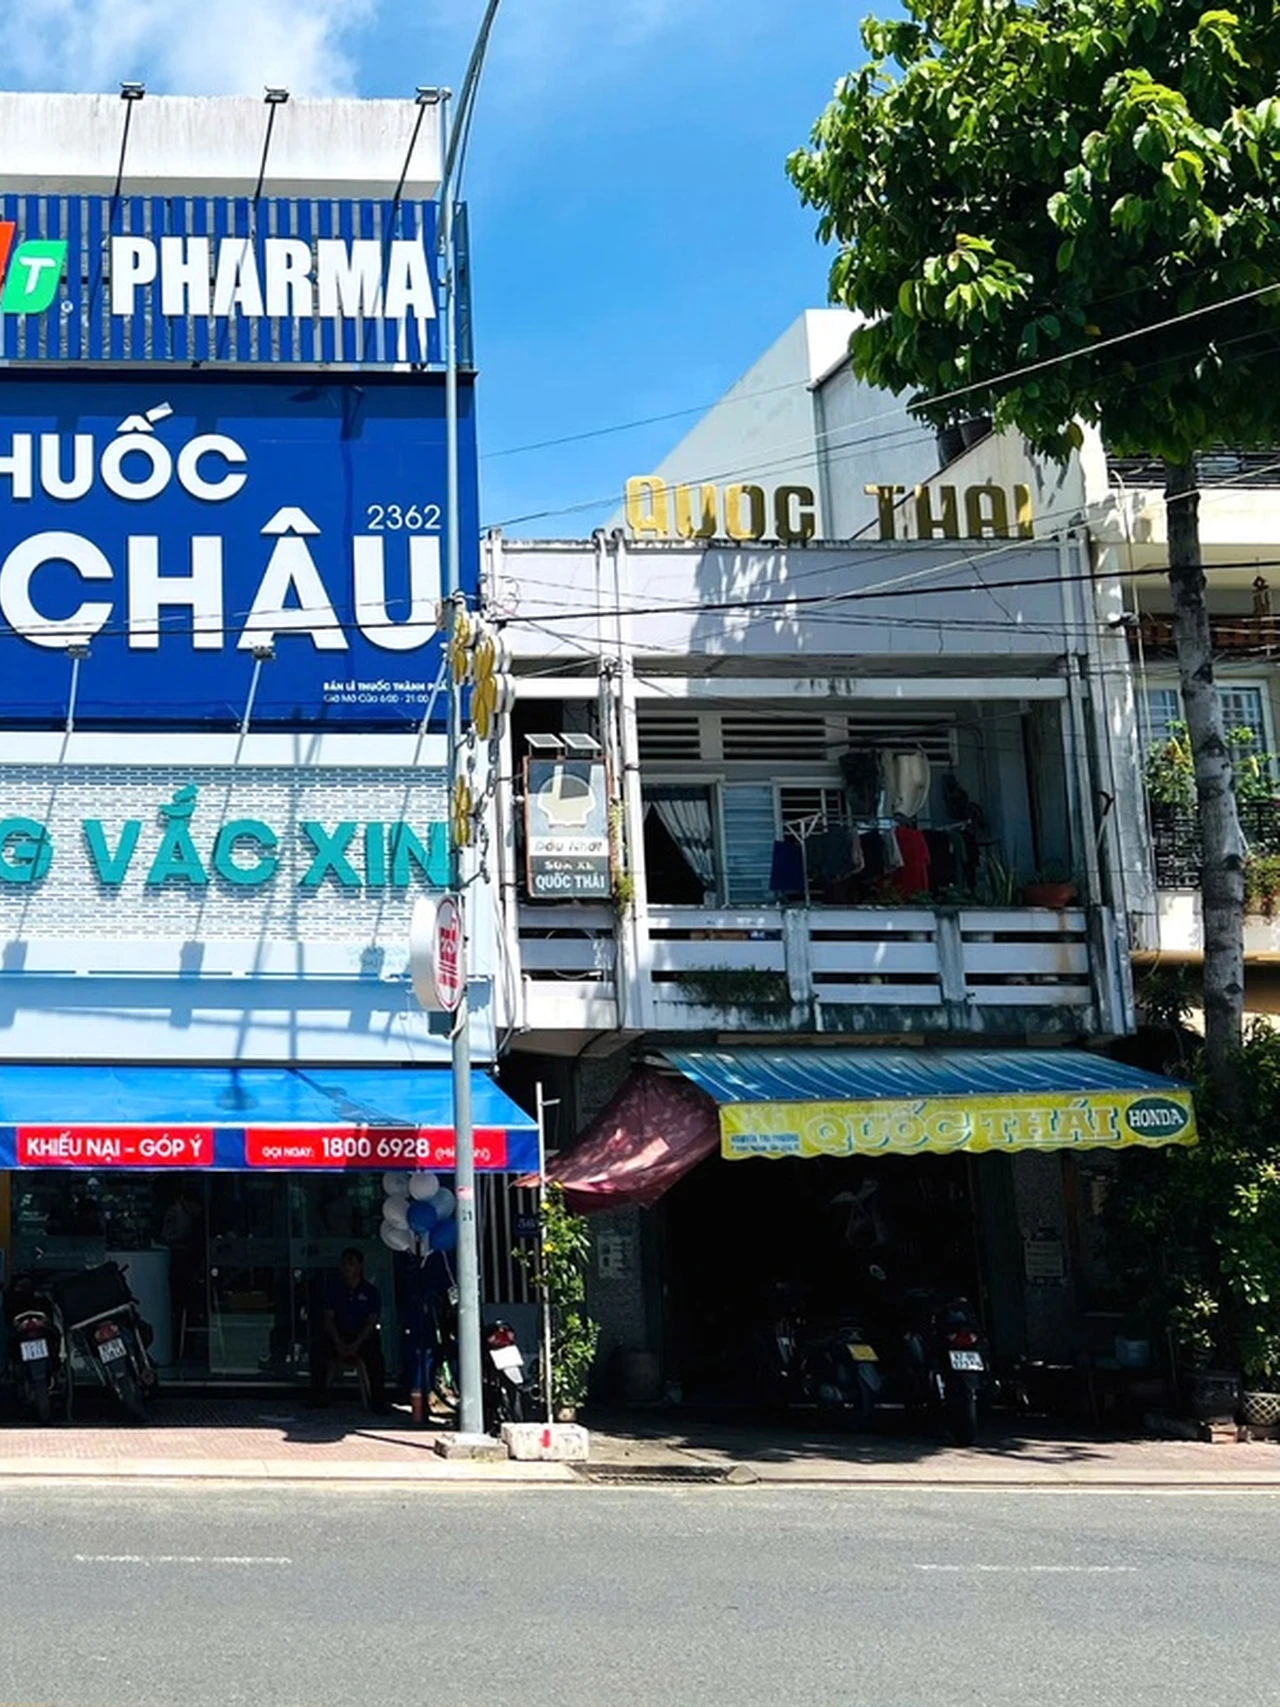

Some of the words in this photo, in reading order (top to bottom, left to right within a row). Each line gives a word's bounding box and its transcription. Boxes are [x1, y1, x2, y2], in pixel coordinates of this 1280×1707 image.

[113, 234, 437, 318] PHARMA
[367, 504, 442, 530] 2362
[0, 507, 440, 650] CHÂU
[83, 782, 279, 885] VẮC
[299, 821, 449, 887] XIN
[535, 872, 572, 890] QUỐC
[574, 872, 605, 888] THÁI
[807, 1102, 970, 1152] QUỐC
[980, 1099, 1121, 1143] THÁI
[1128, 1109, 1184, 1127] HONDA
[26, 1131, 81, 1156] KHIẾU
[87, 1139, 120, 1162] NẠI
[139, 1134, 184, 1156] GÓP
[190, 1134, 202, 1156] Ý
[322, 1137, 370, 1157] 1800
[377, 1137, 429, 1157] 6928
